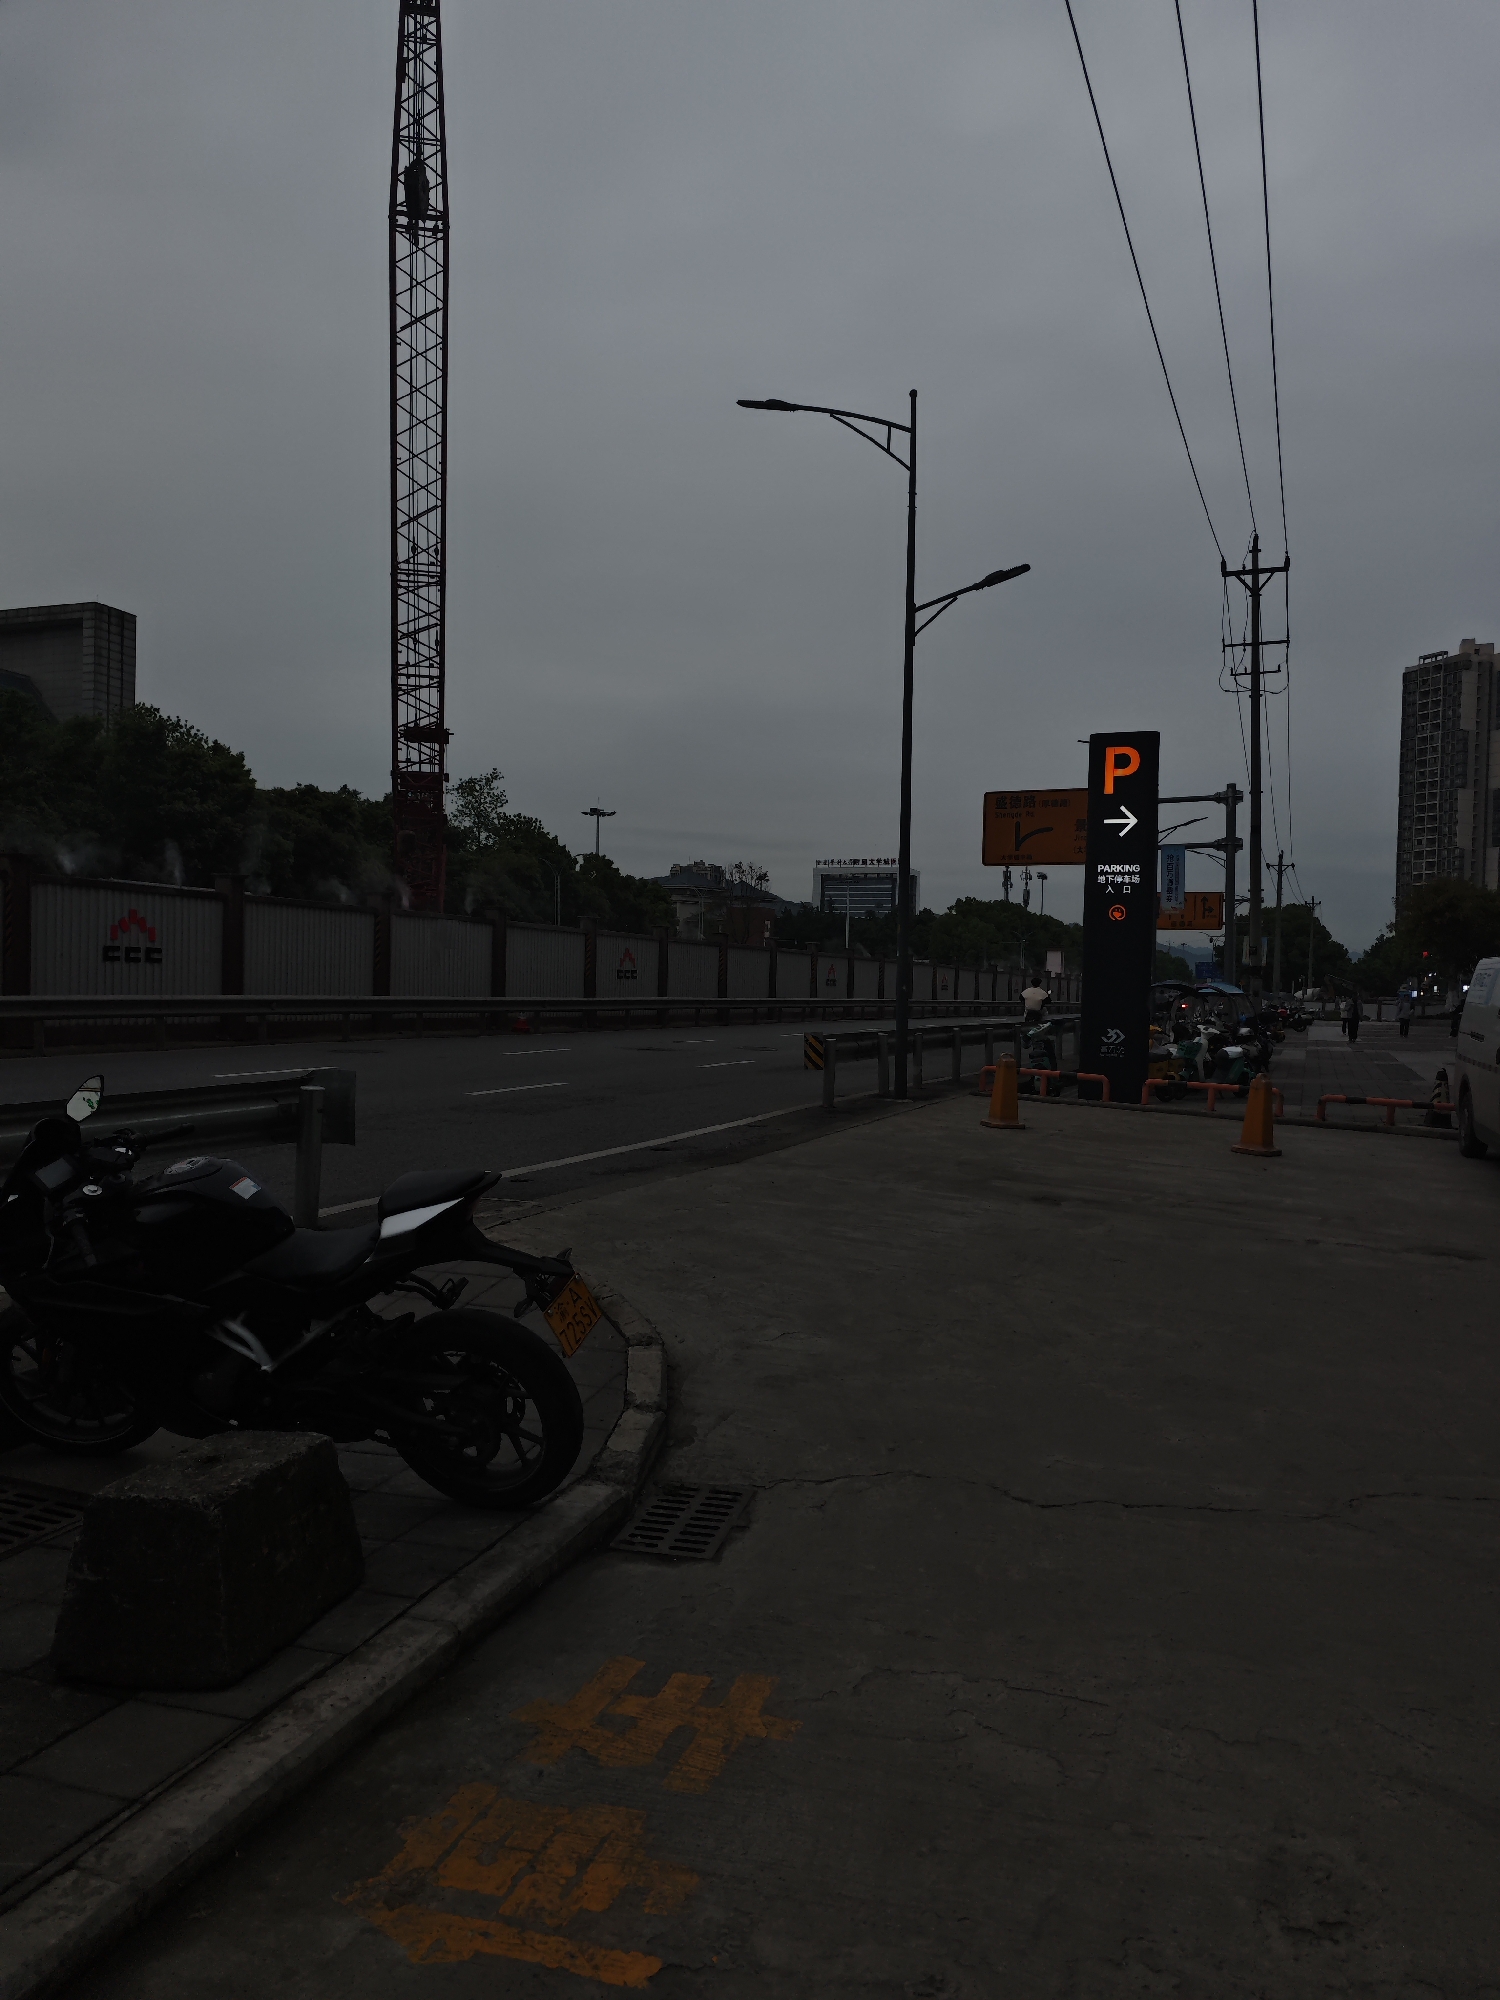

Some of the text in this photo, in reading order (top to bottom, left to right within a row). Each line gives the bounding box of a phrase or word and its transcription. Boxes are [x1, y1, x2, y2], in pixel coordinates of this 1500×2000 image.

[1103, 745, 1141, 795] P
[994, 795, 1036, 809] 盛德路
[994, 811, 1022, 820] Shengde
[1097, 864, 1141, 873] PARKING
[1097, 874, 1141, 884] 地下停车场
[1105, 884, 1132, 894] 入口
[103, 945, 162, 963] CCC
